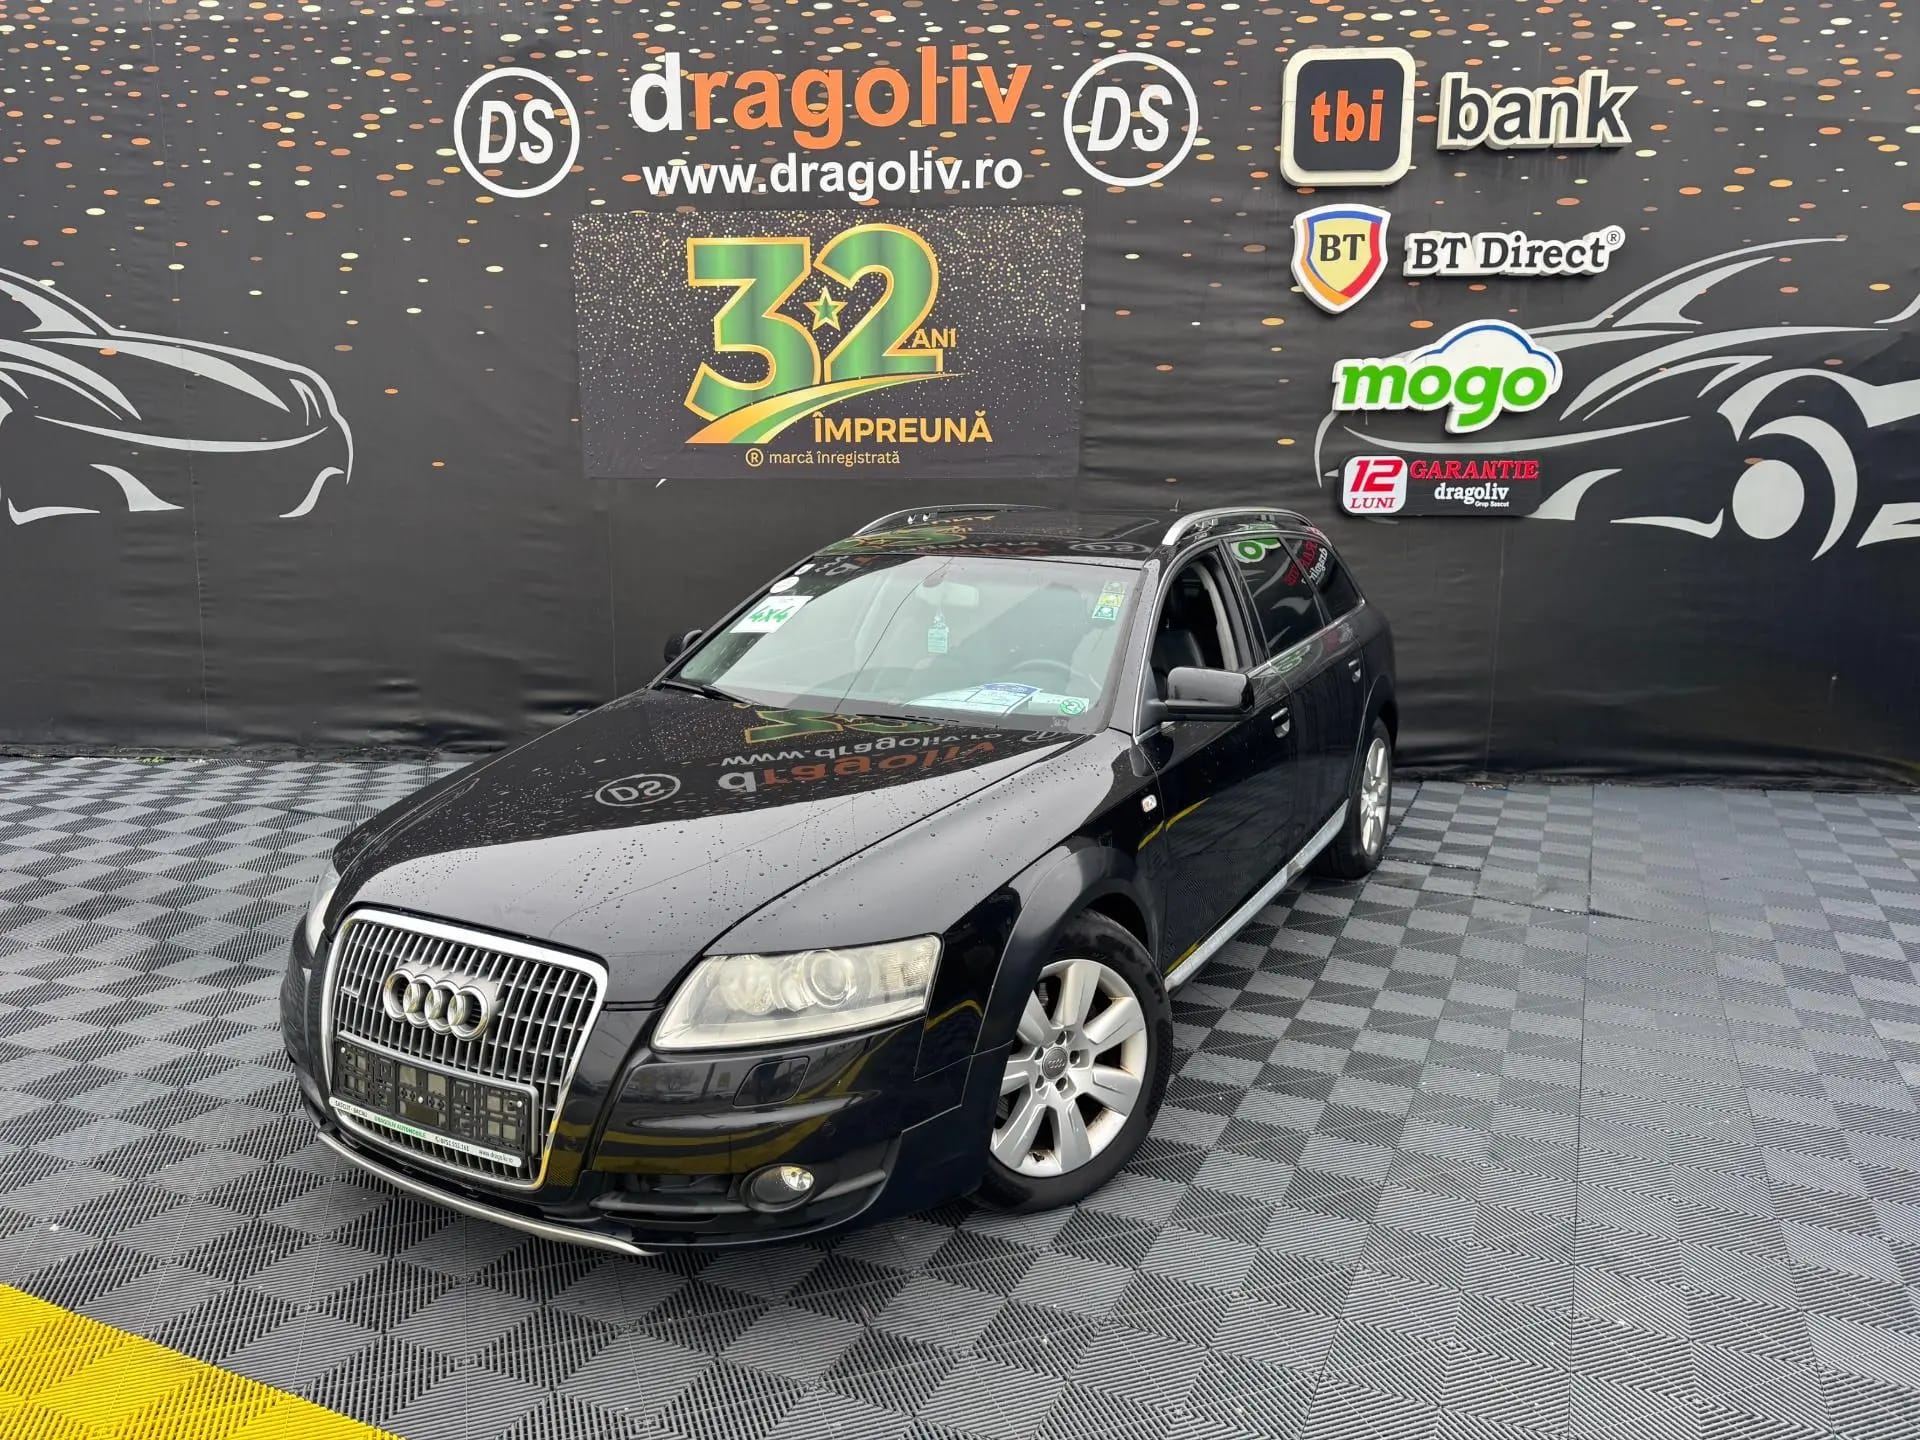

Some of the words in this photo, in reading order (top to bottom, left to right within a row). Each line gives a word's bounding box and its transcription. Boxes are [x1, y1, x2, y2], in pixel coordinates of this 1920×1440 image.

[629, 45, 1032, 150] dragoliv
[1310, 89, 1384, 143] tbi
[1444, 73, 1636, 144] bank
[477, 99, 554, 165] DS
[1086, 84, 1174, 153] DS
[641, 151, 1023, 201] www.dragoliv.ro
[1319, 233, 1366, 262] BT
[1411, 237, 1468, 269] BT
[683, 223, 943, 422] 32
[911, 327, 957, 351] ANI
[1342, 364, 1547, 427] mogo
[814, 410, 993, 444] ÎMPREUNĂ
[769, 450, 814, 464] marcă
[817, 450, 900, 467] înregistrată
[1410, 460, 1540, 480] GARANTIE
[1350, 459, 1403, 492] 12
[1350, 497, 1395, 508] LUNI
[1434, 482, 1509, 505] dragoliv
